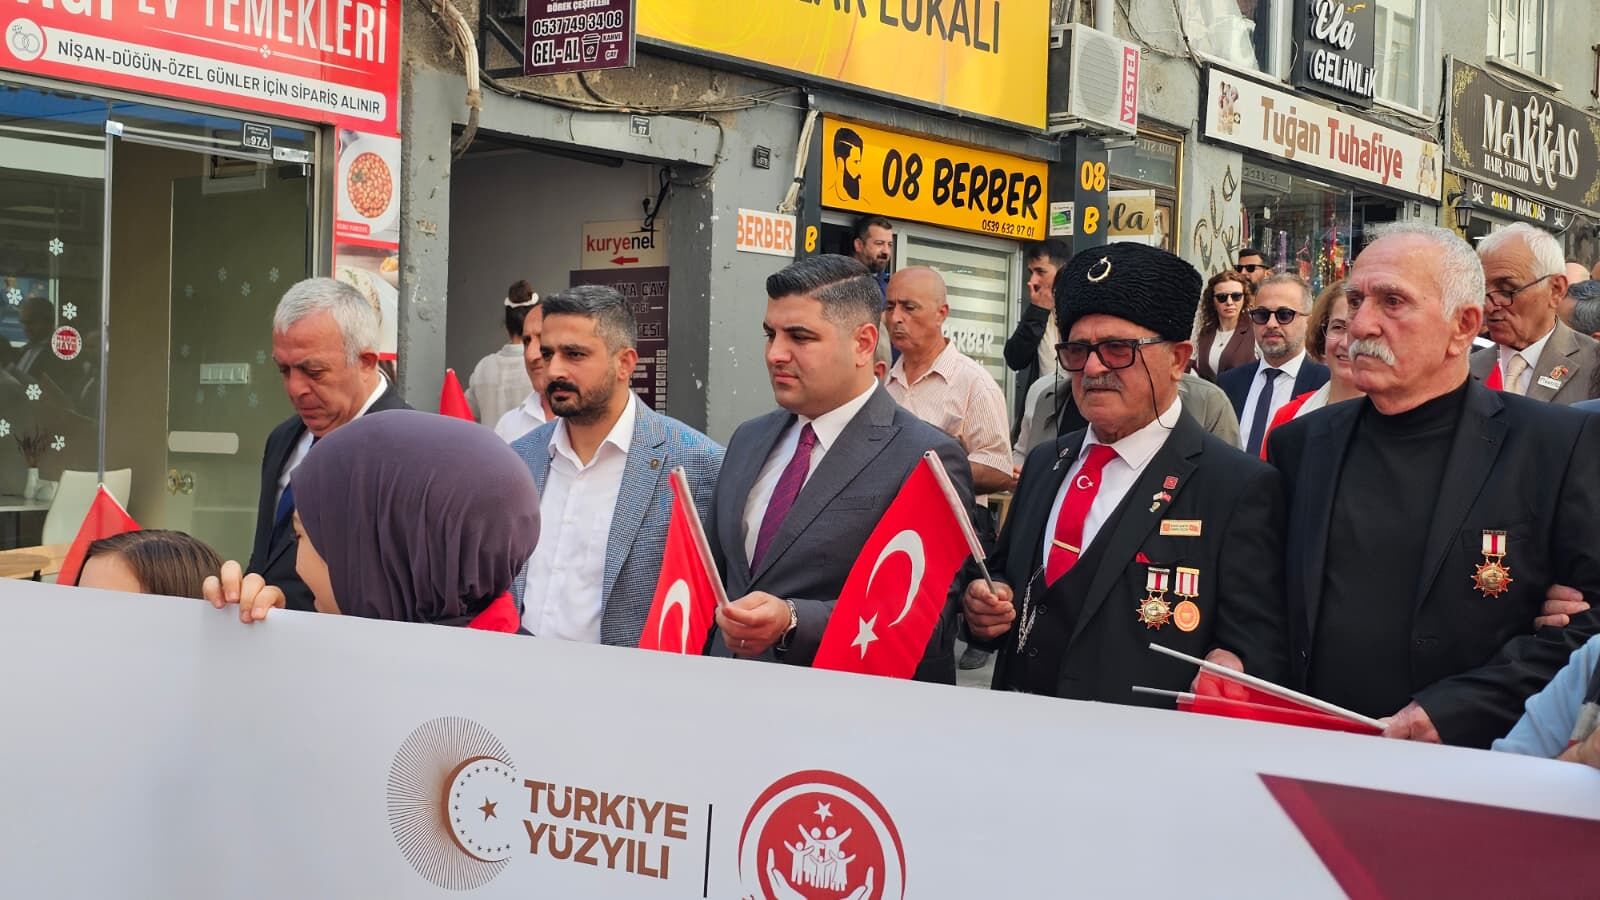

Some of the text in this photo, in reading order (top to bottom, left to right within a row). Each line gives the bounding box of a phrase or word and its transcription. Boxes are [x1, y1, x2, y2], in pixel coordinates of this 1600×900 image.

[533, 10, 624, 37] 0537 749 34 08
[532, 37, 580, 67] GEL-AL
[58, 38, 380, 114] NİŞAN-DÜĞÜN-ÖZEL GÜNLER İÇİN SİPARİŞ ALINIR
[1122, 48, 1136, 123] VESTEL
[251, 136, 269, 147] 97A
[1328, 117, 1403, 185] Tuhafiye
[1081, 161, 1106, 192] 08
[1484, 154, 1529, 182] HAIR STUDIO
[882, 149, 1042, 220] 08 BERBER
[1083, 206, 1100, 234] B
[1108, 203, 1150, 231] la
[1516, 198, 1546, 221] MAKKAS
[736, 214, 793, 250] BERBER
[805, 225, 818, 253] B
[981, 219, 999, 232] 0539
[1001, 221, 1015, 235] 632
[1016, 224, 1026, 236] 97
[523, 779, 689, 840] TÜRKİYE
[523, 819, 670, 880] YÜZYILI
